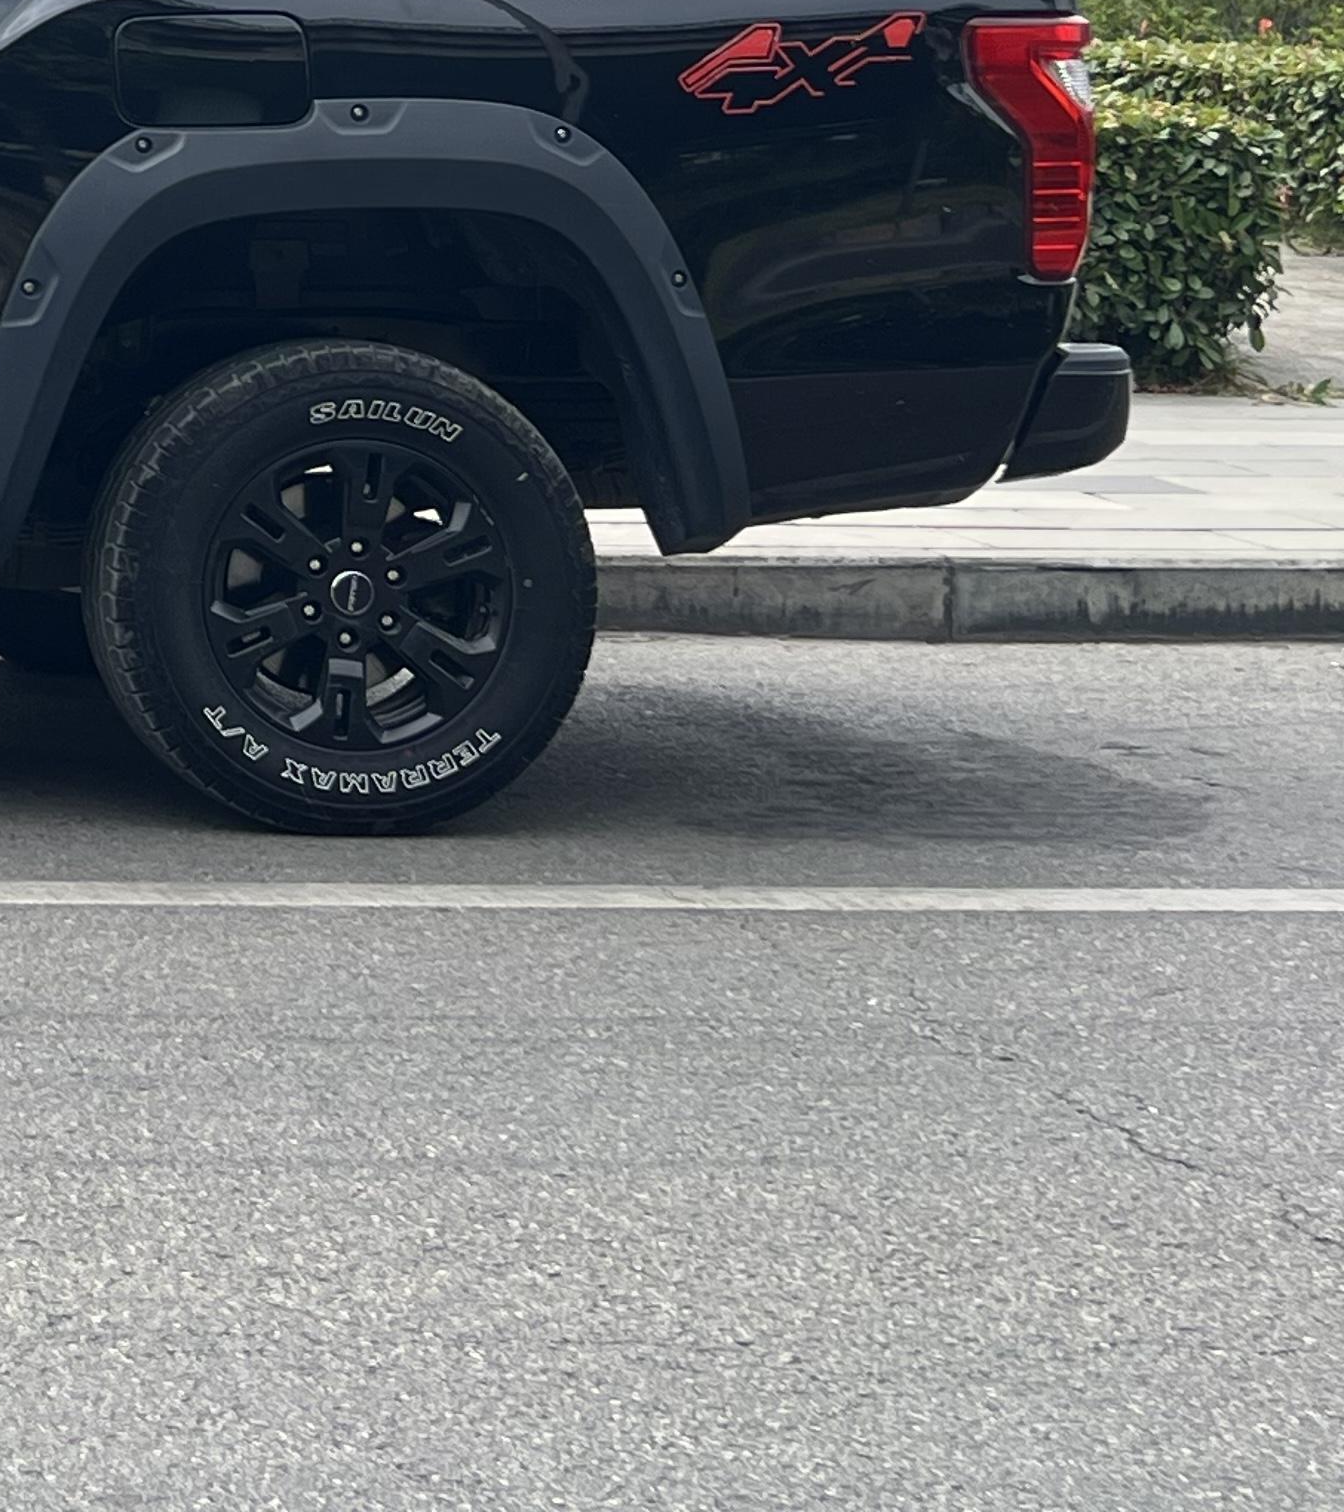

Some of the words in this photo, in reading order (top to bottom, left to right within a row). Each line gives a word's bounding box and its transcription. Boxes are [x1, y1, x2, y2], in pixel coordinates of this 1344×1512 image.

[309, 399, 464, 442] SAILUN
[203, 704, 269, 761] A/T
[280, 727, 502, 794] TERRAMAX
